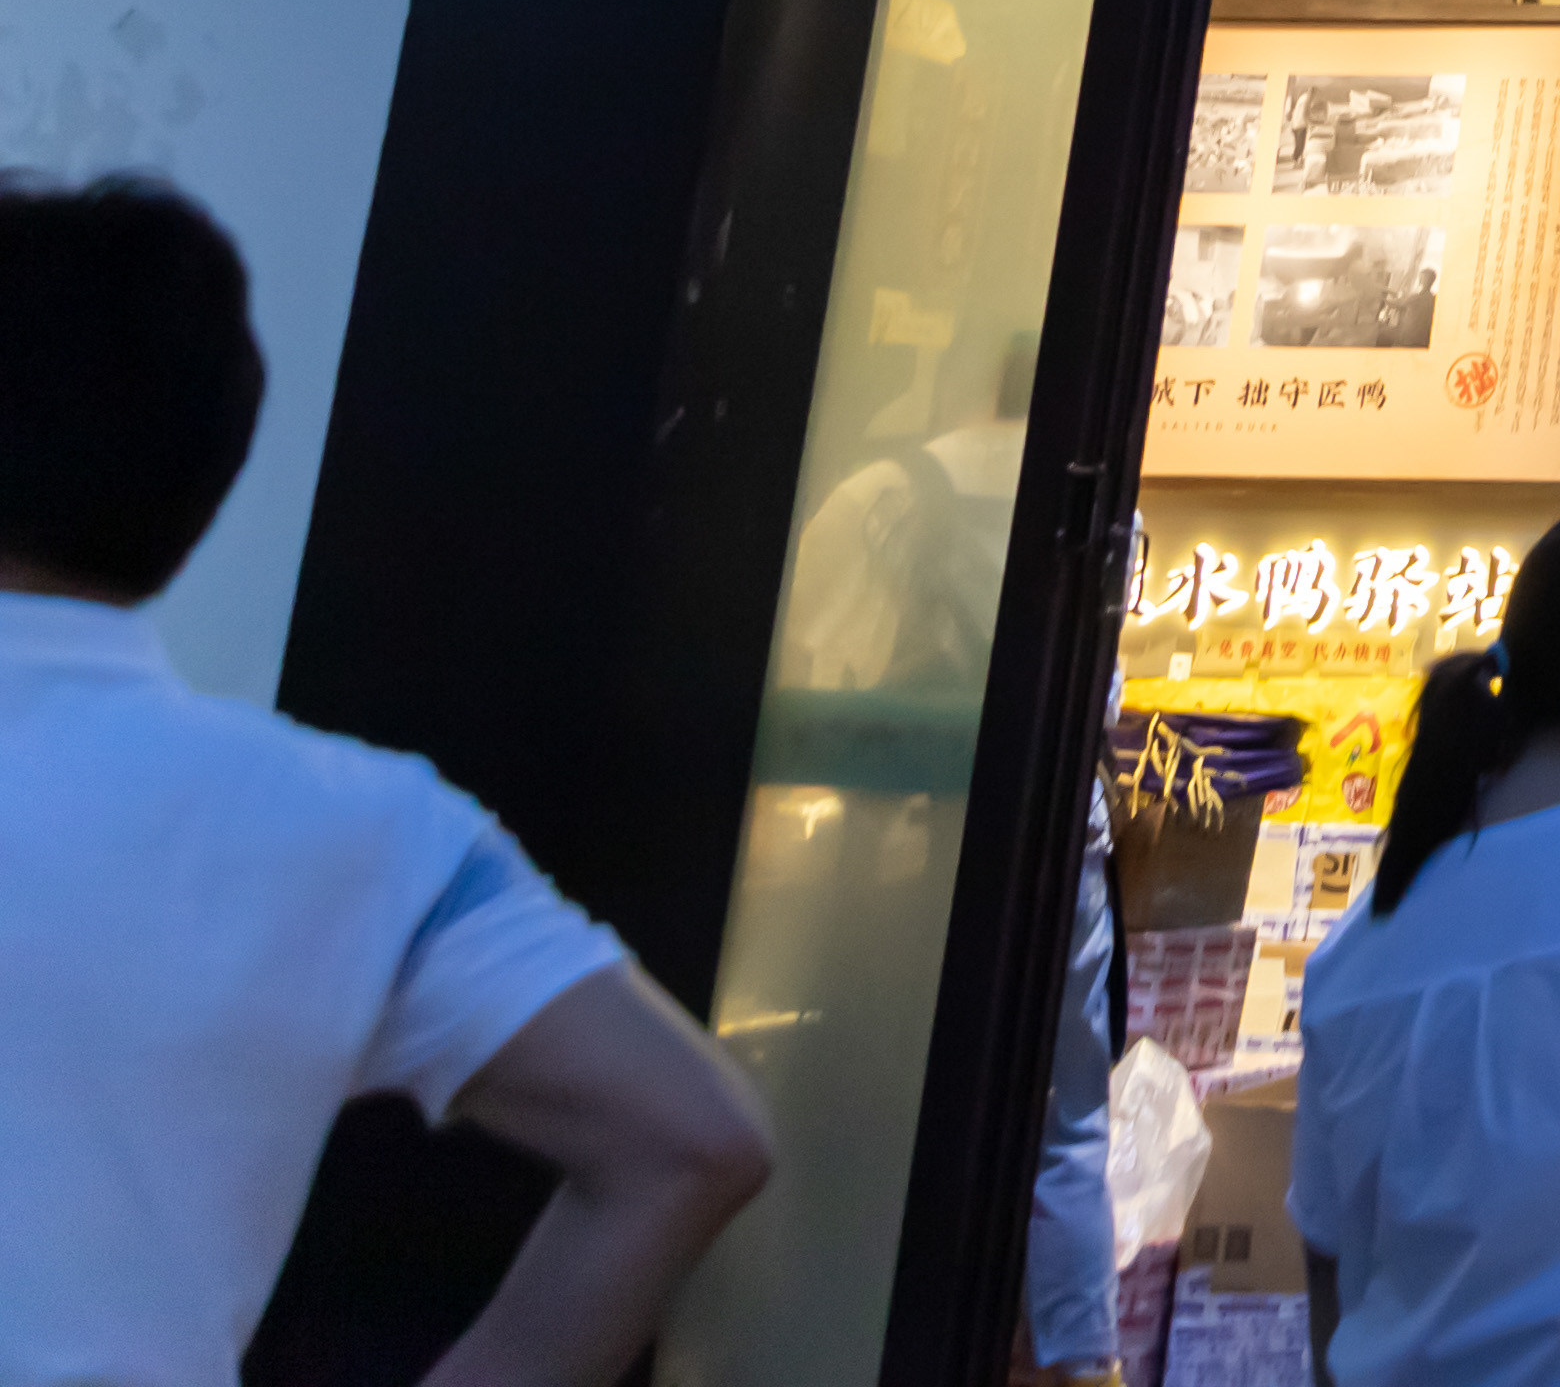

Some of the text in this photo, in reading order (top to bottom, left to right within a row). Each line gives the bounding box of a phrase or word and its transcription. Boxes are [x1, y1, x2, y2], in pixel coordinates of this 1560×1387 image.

[1237, 377, 1388, 411] 拙守匠鸭
[1127, 537, 1520, 635] 水鸭驿站
[1313, 641, 1391, 663] 代办快递
